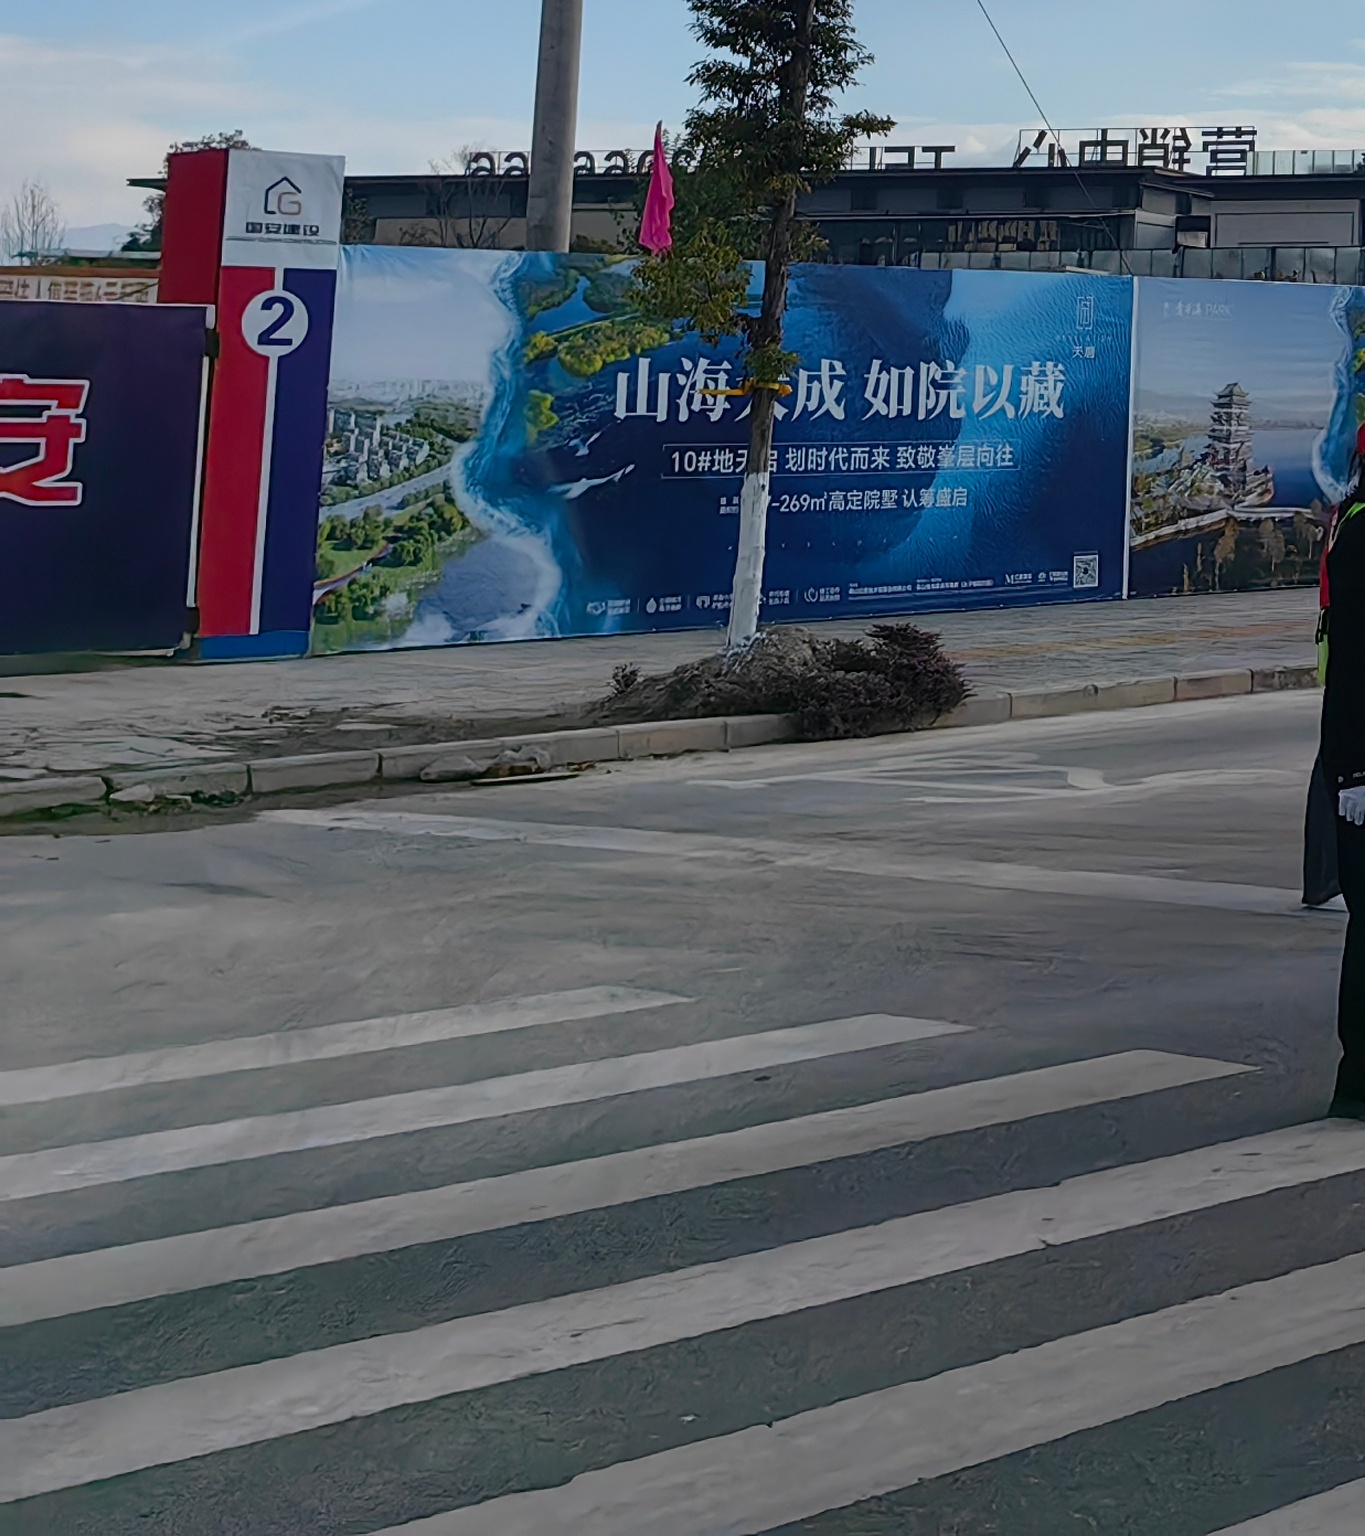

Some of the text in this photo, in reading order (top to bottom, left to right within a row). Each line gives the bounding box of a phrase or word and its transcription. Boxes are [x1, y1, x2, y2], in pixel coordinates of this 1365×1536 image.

[257, 297, 294, 346] 2
[861, 358, 1066, 422] 如院以藏
[785, 444, 891, 472] 划时代而来
